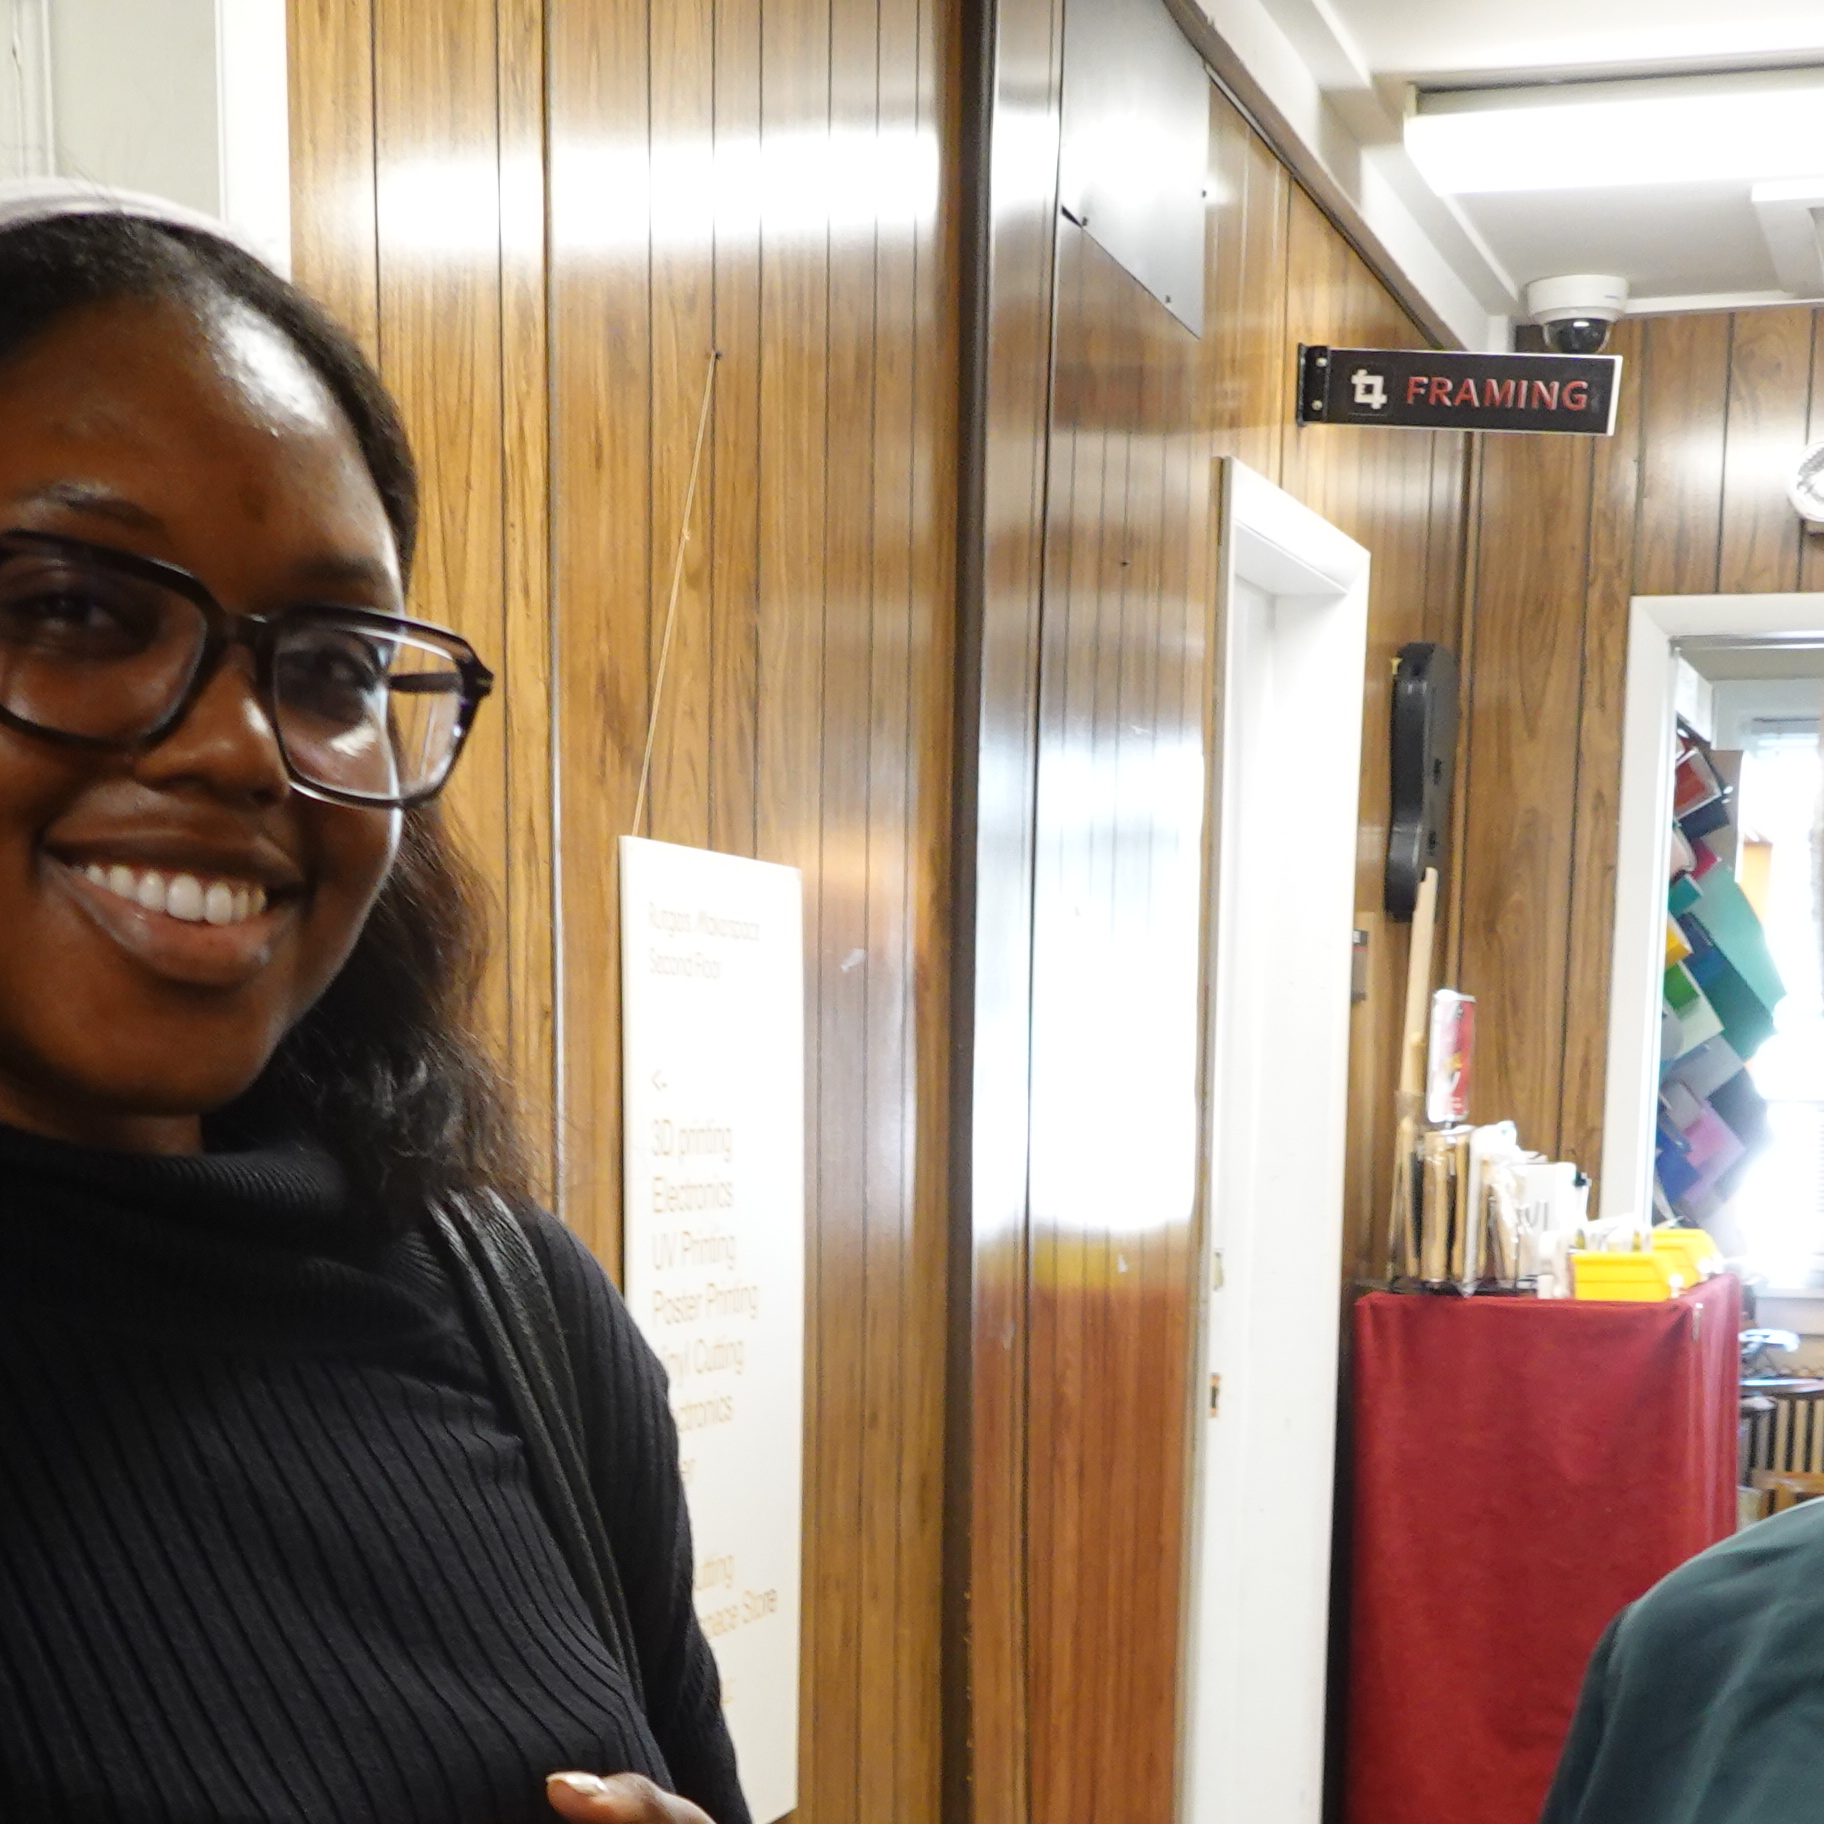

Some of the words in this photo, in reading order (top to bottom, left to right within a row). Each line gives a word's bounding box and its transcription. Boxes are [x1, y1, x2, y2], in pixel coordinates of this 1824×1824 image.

[1405, 375, 1590, 413] FRAMING
[649, 946, 693, 977] Second
[694, 951, 723, 980] Floor
[651, 1118, 675, 1157] 3D
[678, 1117, 733, 1166] printing
[652, 1174, 734, 1215] Electronics
[652, 1231, 677, 1272] UV
[680, 1229, 736, 1271] Printing
[652, 1289, 702, 1328] Poster
[705, 1282, 759, 1321] Printing
[694, 1336, 745, 1377] Cutting
[743, 1588, 778, 1625] Store
